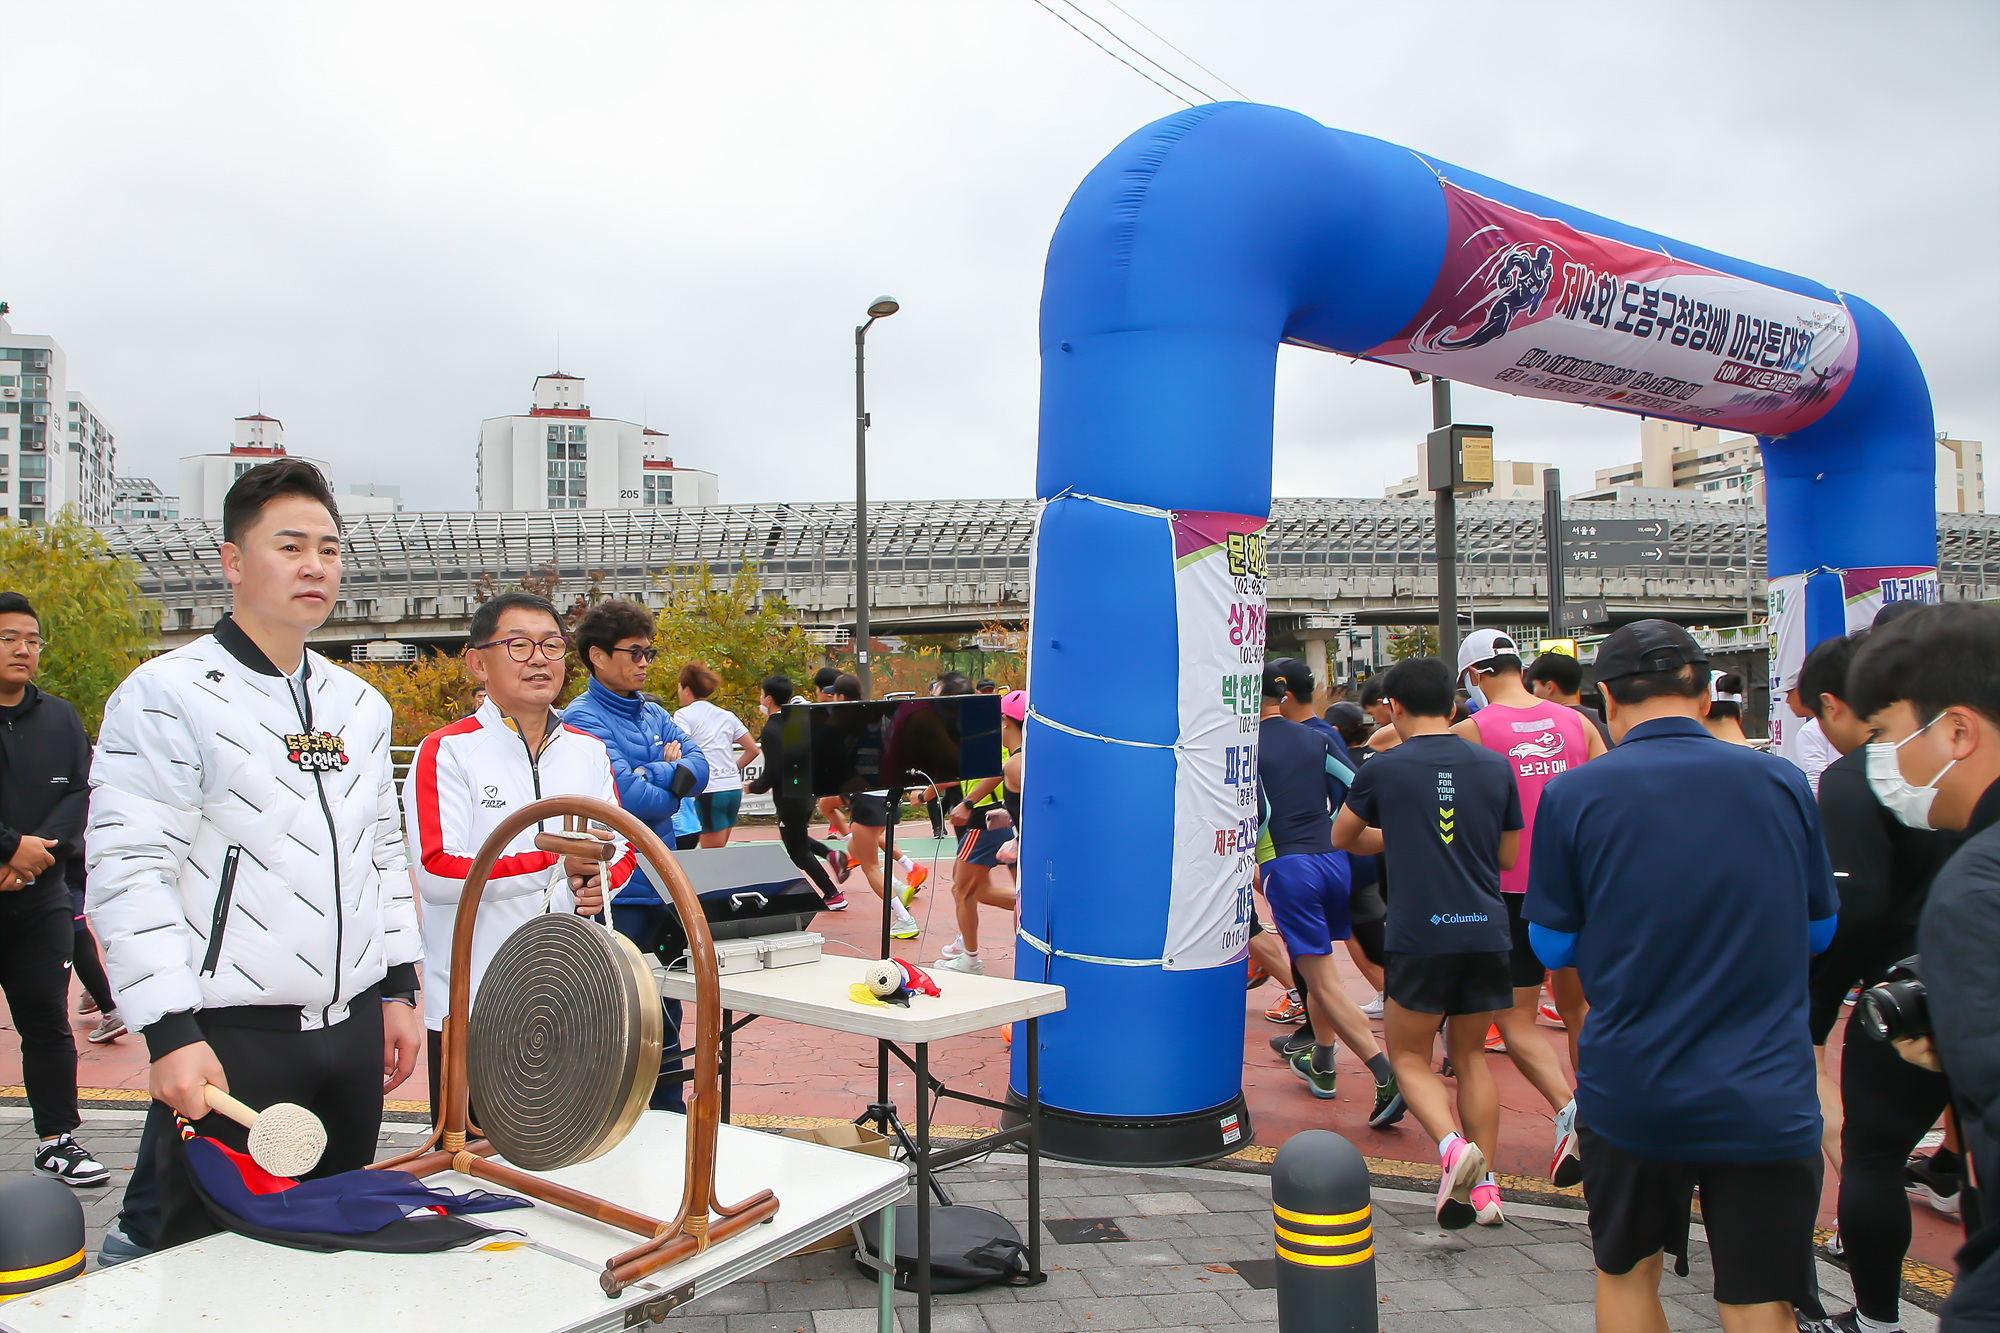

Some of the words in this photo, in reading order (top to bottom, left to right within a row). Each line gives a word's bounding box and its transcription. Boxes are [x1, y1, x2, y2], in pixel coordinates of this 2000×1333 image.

[1554, 263, 1617, 328] 제4회
[1613, 283, 1730, 355] 도봉구청장배
[1727, 313, 1815, 373] 마라톤대회
[1718, 364, 1741, 382] 10K
[620, 490, 639, 499] 205
[286, 734, 344, 751] 도봉구청장
[300, 752, 343, 770] 오언석
[1520, 760, 1567, 777] 보라매
[1439, 779, 1452, 787] FOR
[1441, 913, 1489, 924] Columbia
